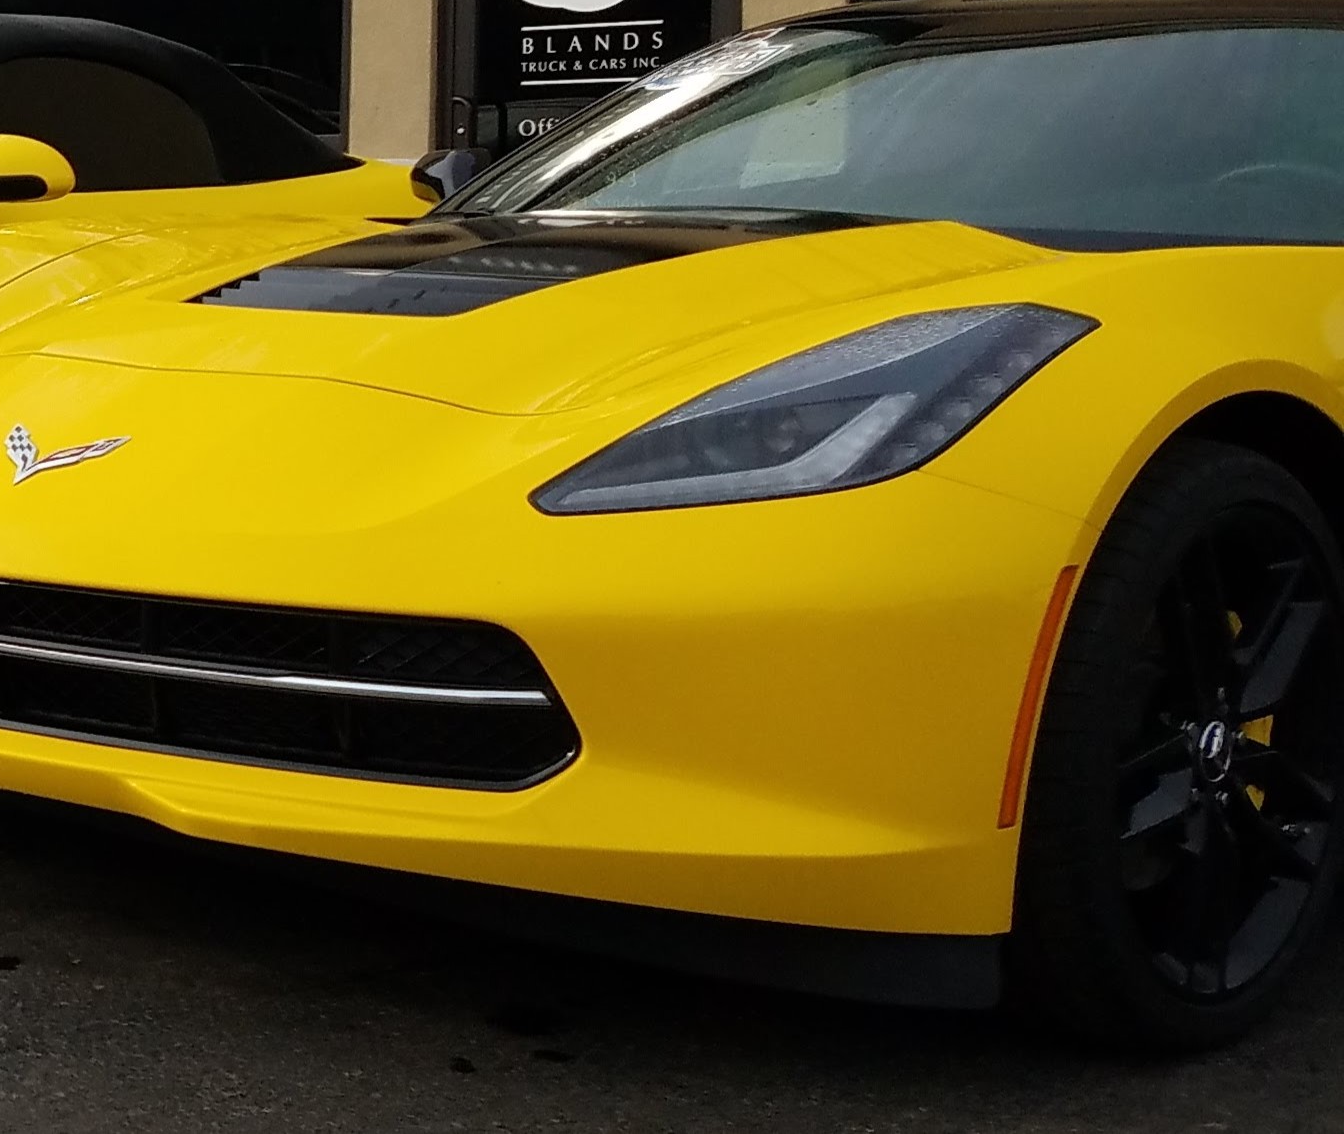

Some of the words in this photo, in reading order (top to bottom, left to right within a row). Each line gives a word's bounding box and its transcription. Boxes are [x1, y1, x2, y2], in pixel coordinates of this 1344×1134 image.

[521, 31, 664, 55] BLANDS
[520, 60, 567, 73] TRUCK
[572, 60, 583, 71] &
[588, 57, 627, 70] CARS
